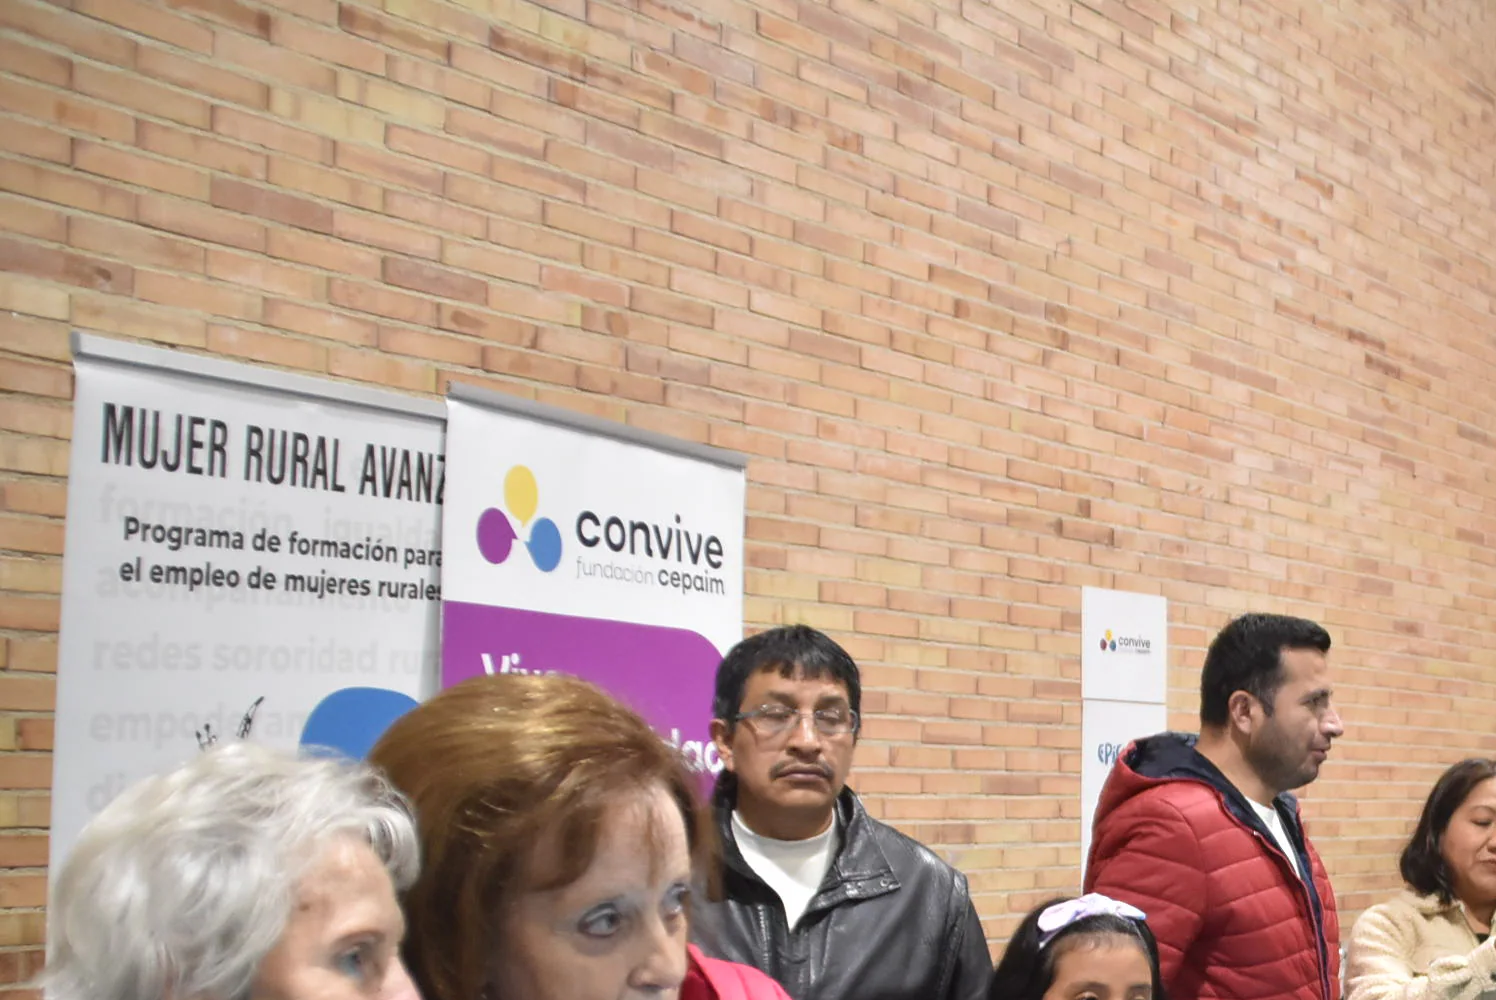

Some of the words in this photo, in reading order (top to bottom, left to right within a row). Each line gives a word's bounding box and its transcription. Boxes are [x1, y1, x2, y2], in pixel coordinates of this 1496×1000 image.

[101, 401, 228, 479] MUJER
[243, 423, 346, 494] RURAL
[123, 515, 245, 551] Programa
[252, 528, 281, 554] de
[288, 531, 398, 564] formación
[575, 510, 724, 570] convive
[119, 556, 141, 582] el
[149, 562, 240, 592] empleo
[247, 566, 277, 591] de
[284, 569, 371, 600] mujeres
[576, 556, 654, 586] fundación
[657, 568, 725, 595] cepaim
[92, 631, 203, 672] redes
[210, 635, 378, 674] sororidad
[1118, 633, 1151, 649] convive
